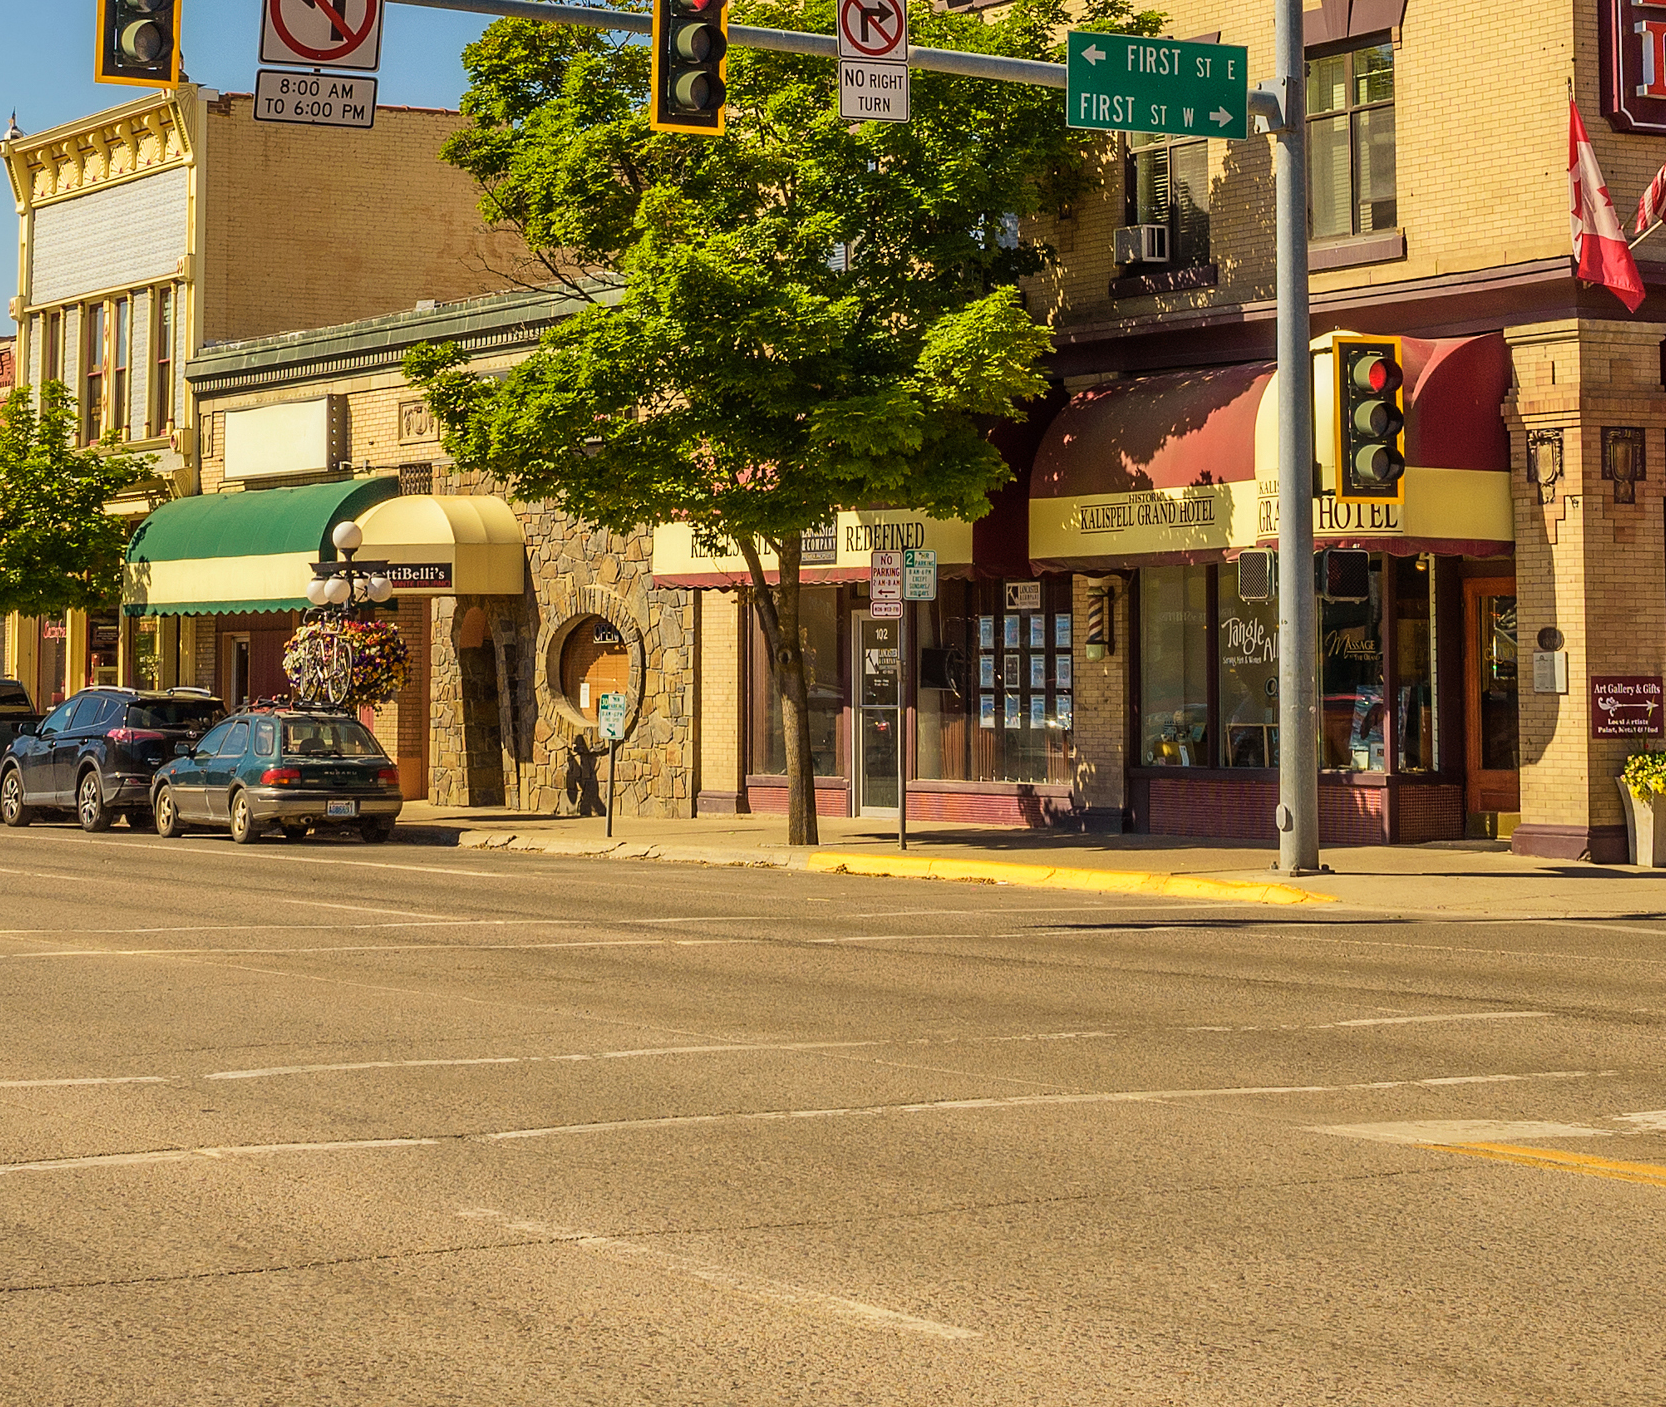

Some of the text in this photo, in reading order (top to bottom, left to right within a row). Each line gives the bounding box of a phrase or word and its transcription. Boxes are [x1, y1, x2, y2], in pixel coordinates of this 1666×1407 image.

[1127, 45, 1236, 80] FIRST ST E
[280, 77, 354, 101] 8:00 AM
[844, 68, 904, 92] NO RIGHT
[265, 97, 365, 122] TO 6:00 PM
[858, 95, 890, 113] TURN
[1080, 93, 1194, 128] FIRST ST W
[1080, 500, 1215, 530] KALISPELL GRAND HOTEL
[1318, 497, 1398, 530] HOTEL
[845, 522, 925, 552] REDEFINED
[880, 555, 893, 565] NO
[906, 552, 913, 565] 2
[382, 567, 445, 580] ttiBelli's
[873, 567, 900, 577] PARKING
[875, 628, 889, 640] 102
[1221, 617, 1265, 655] Tangle
[1594, 683, 1661, 696] Art Gallery & Gifts
